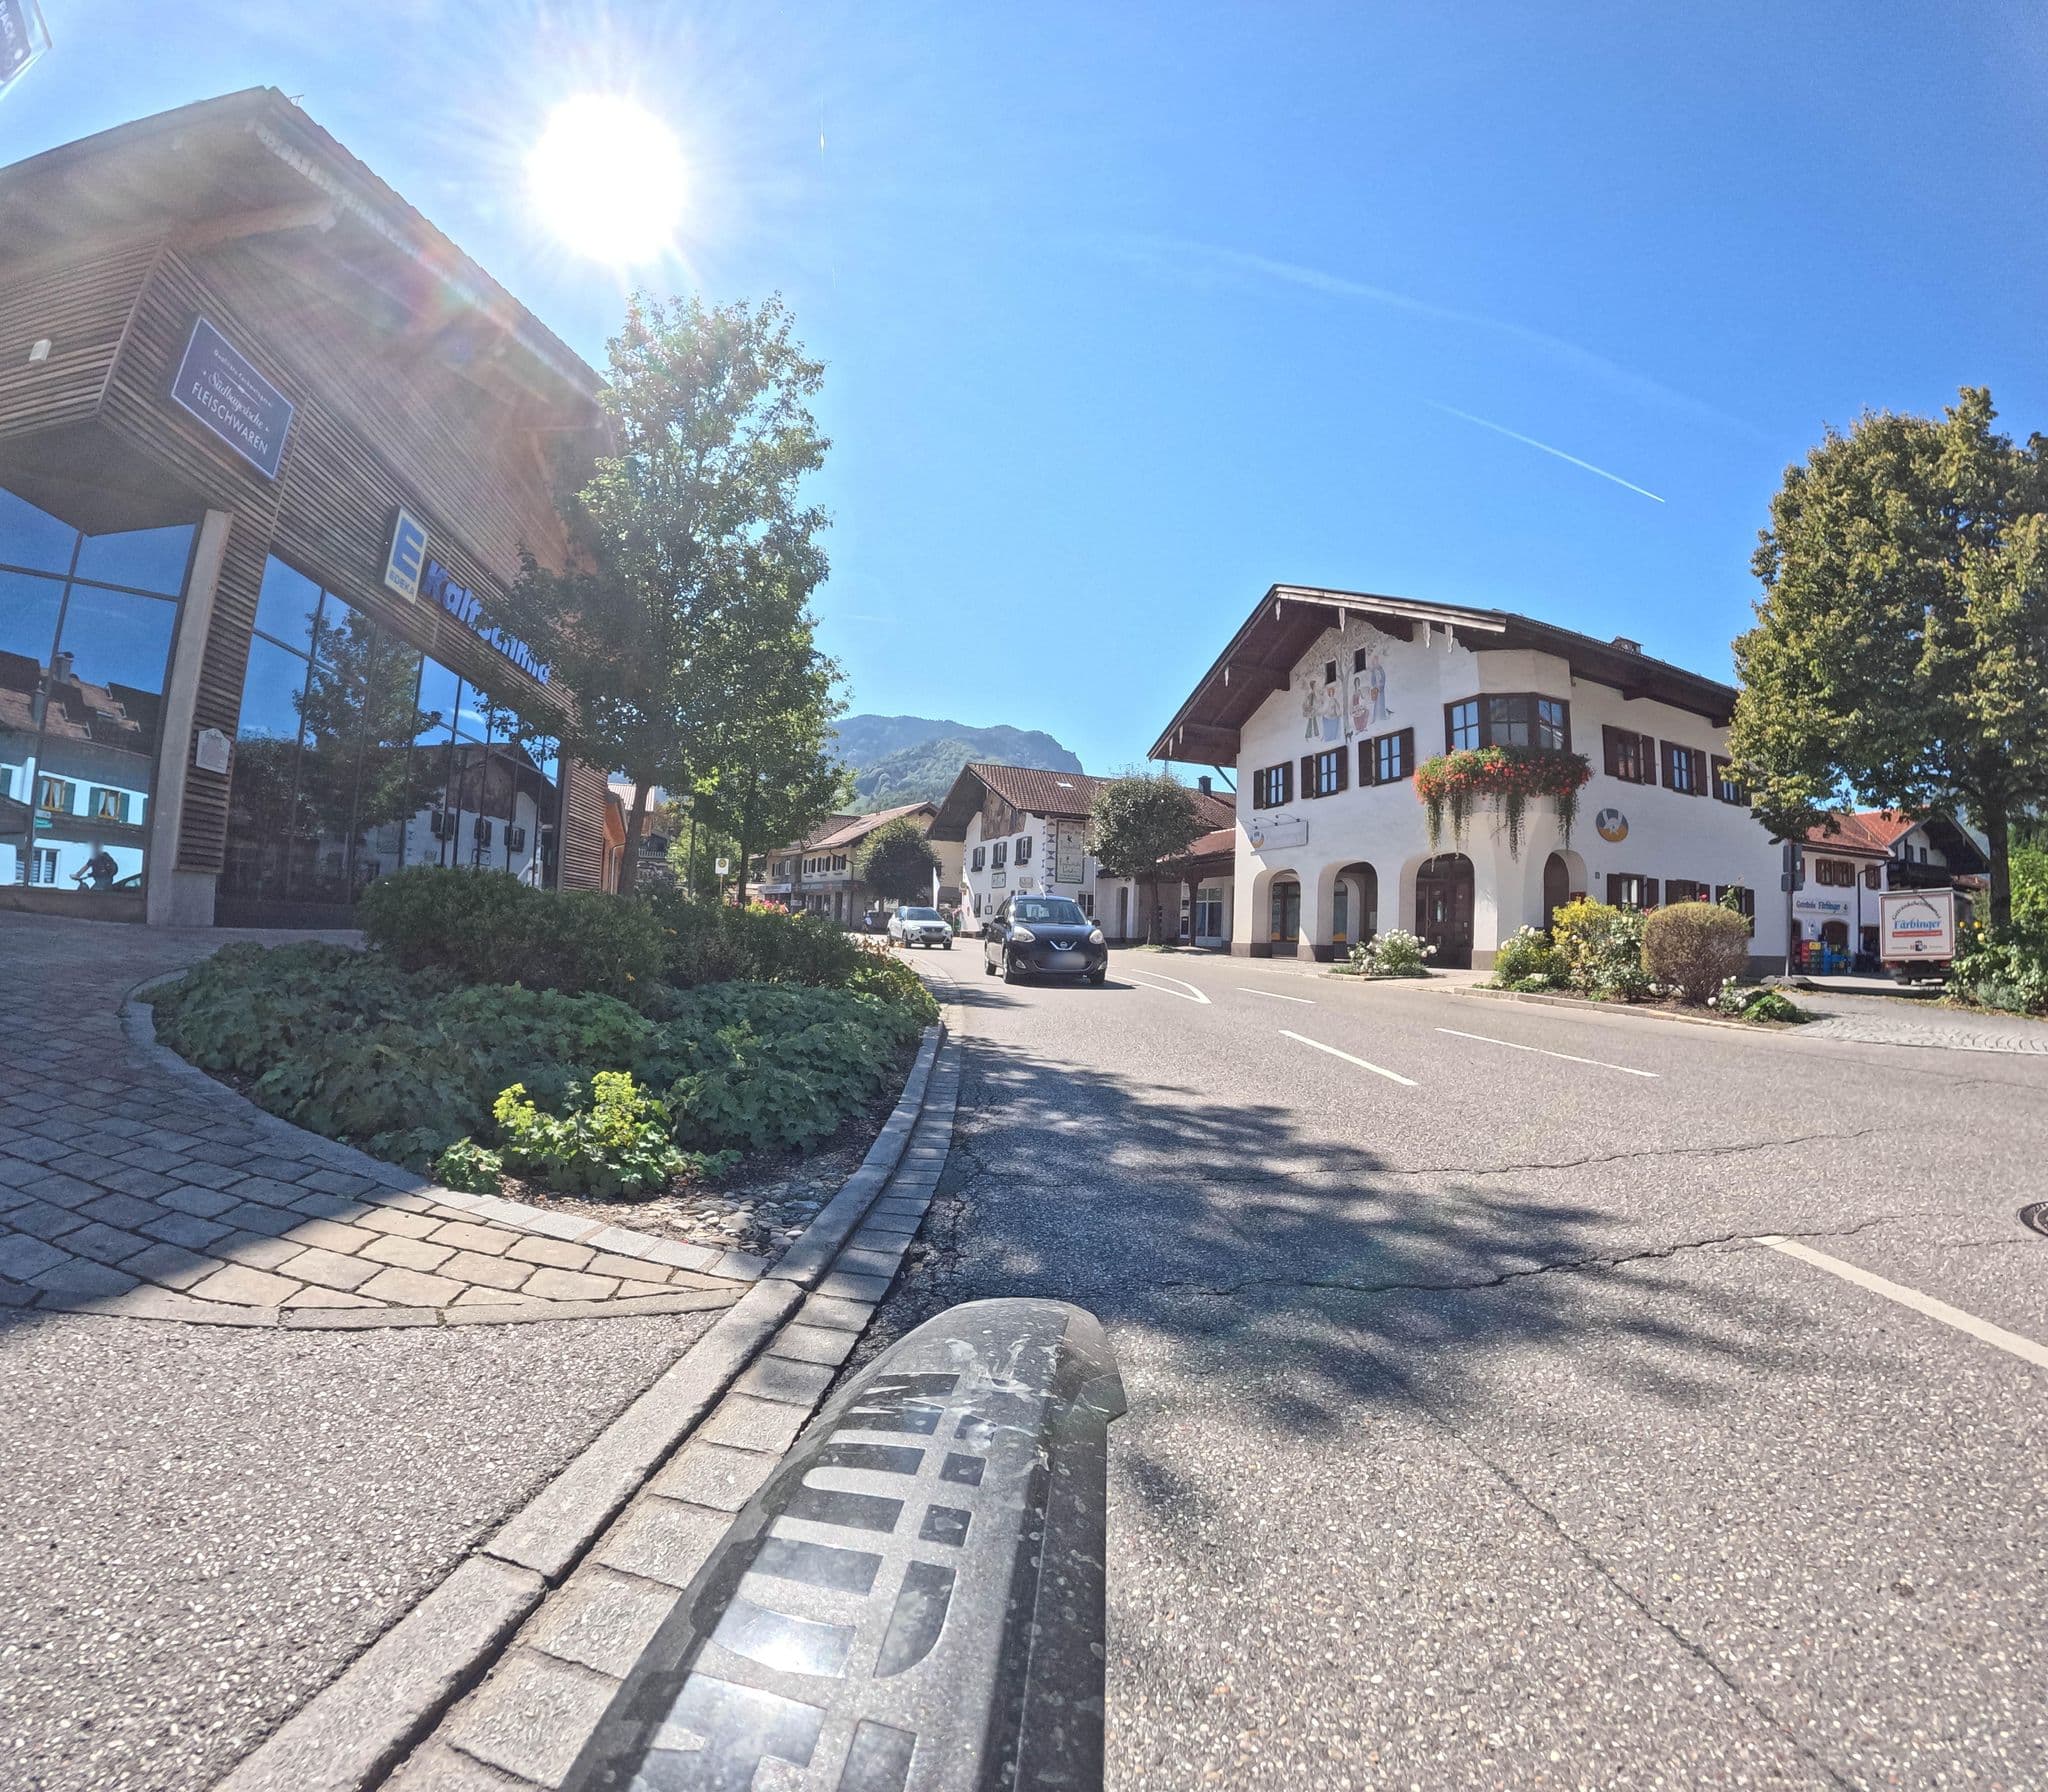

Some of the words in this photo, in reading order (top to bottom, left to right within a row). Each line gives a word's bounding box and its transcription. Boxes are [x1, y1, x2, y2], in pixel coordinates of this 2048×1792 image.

[192, 382, 269, 454] FLEISCHWAREN
[208, 371, 264, 429] Südbayerische
[388, 571, 416, 597] EDEKA
